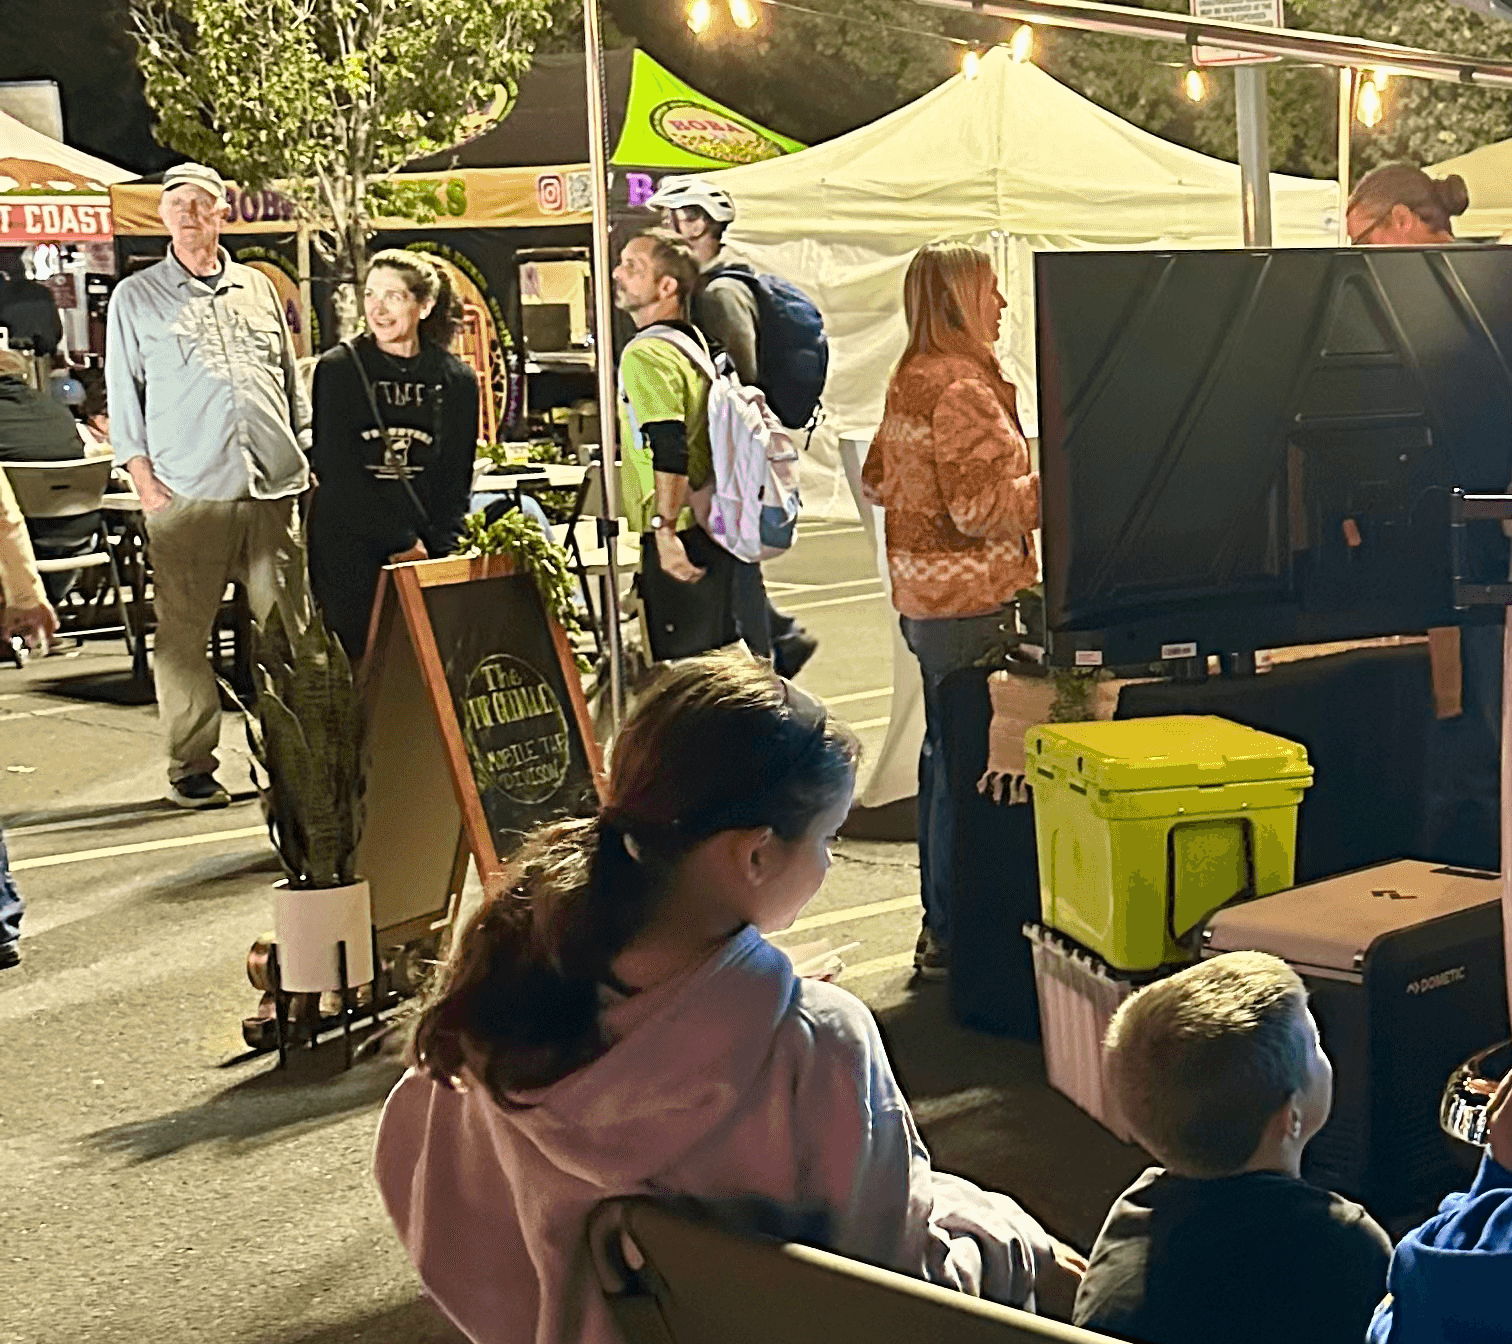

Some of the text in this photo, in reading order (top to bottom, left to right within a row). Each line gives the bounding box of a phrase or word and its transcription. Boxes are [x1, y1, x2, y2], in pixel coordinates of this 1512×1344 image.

[24, 205, 112, 234] COAST
[480, 663, 523, 692] The
[486, 740, 540, 773] MOBILE
[1420, 966, 1465, 994] DOMETIC
